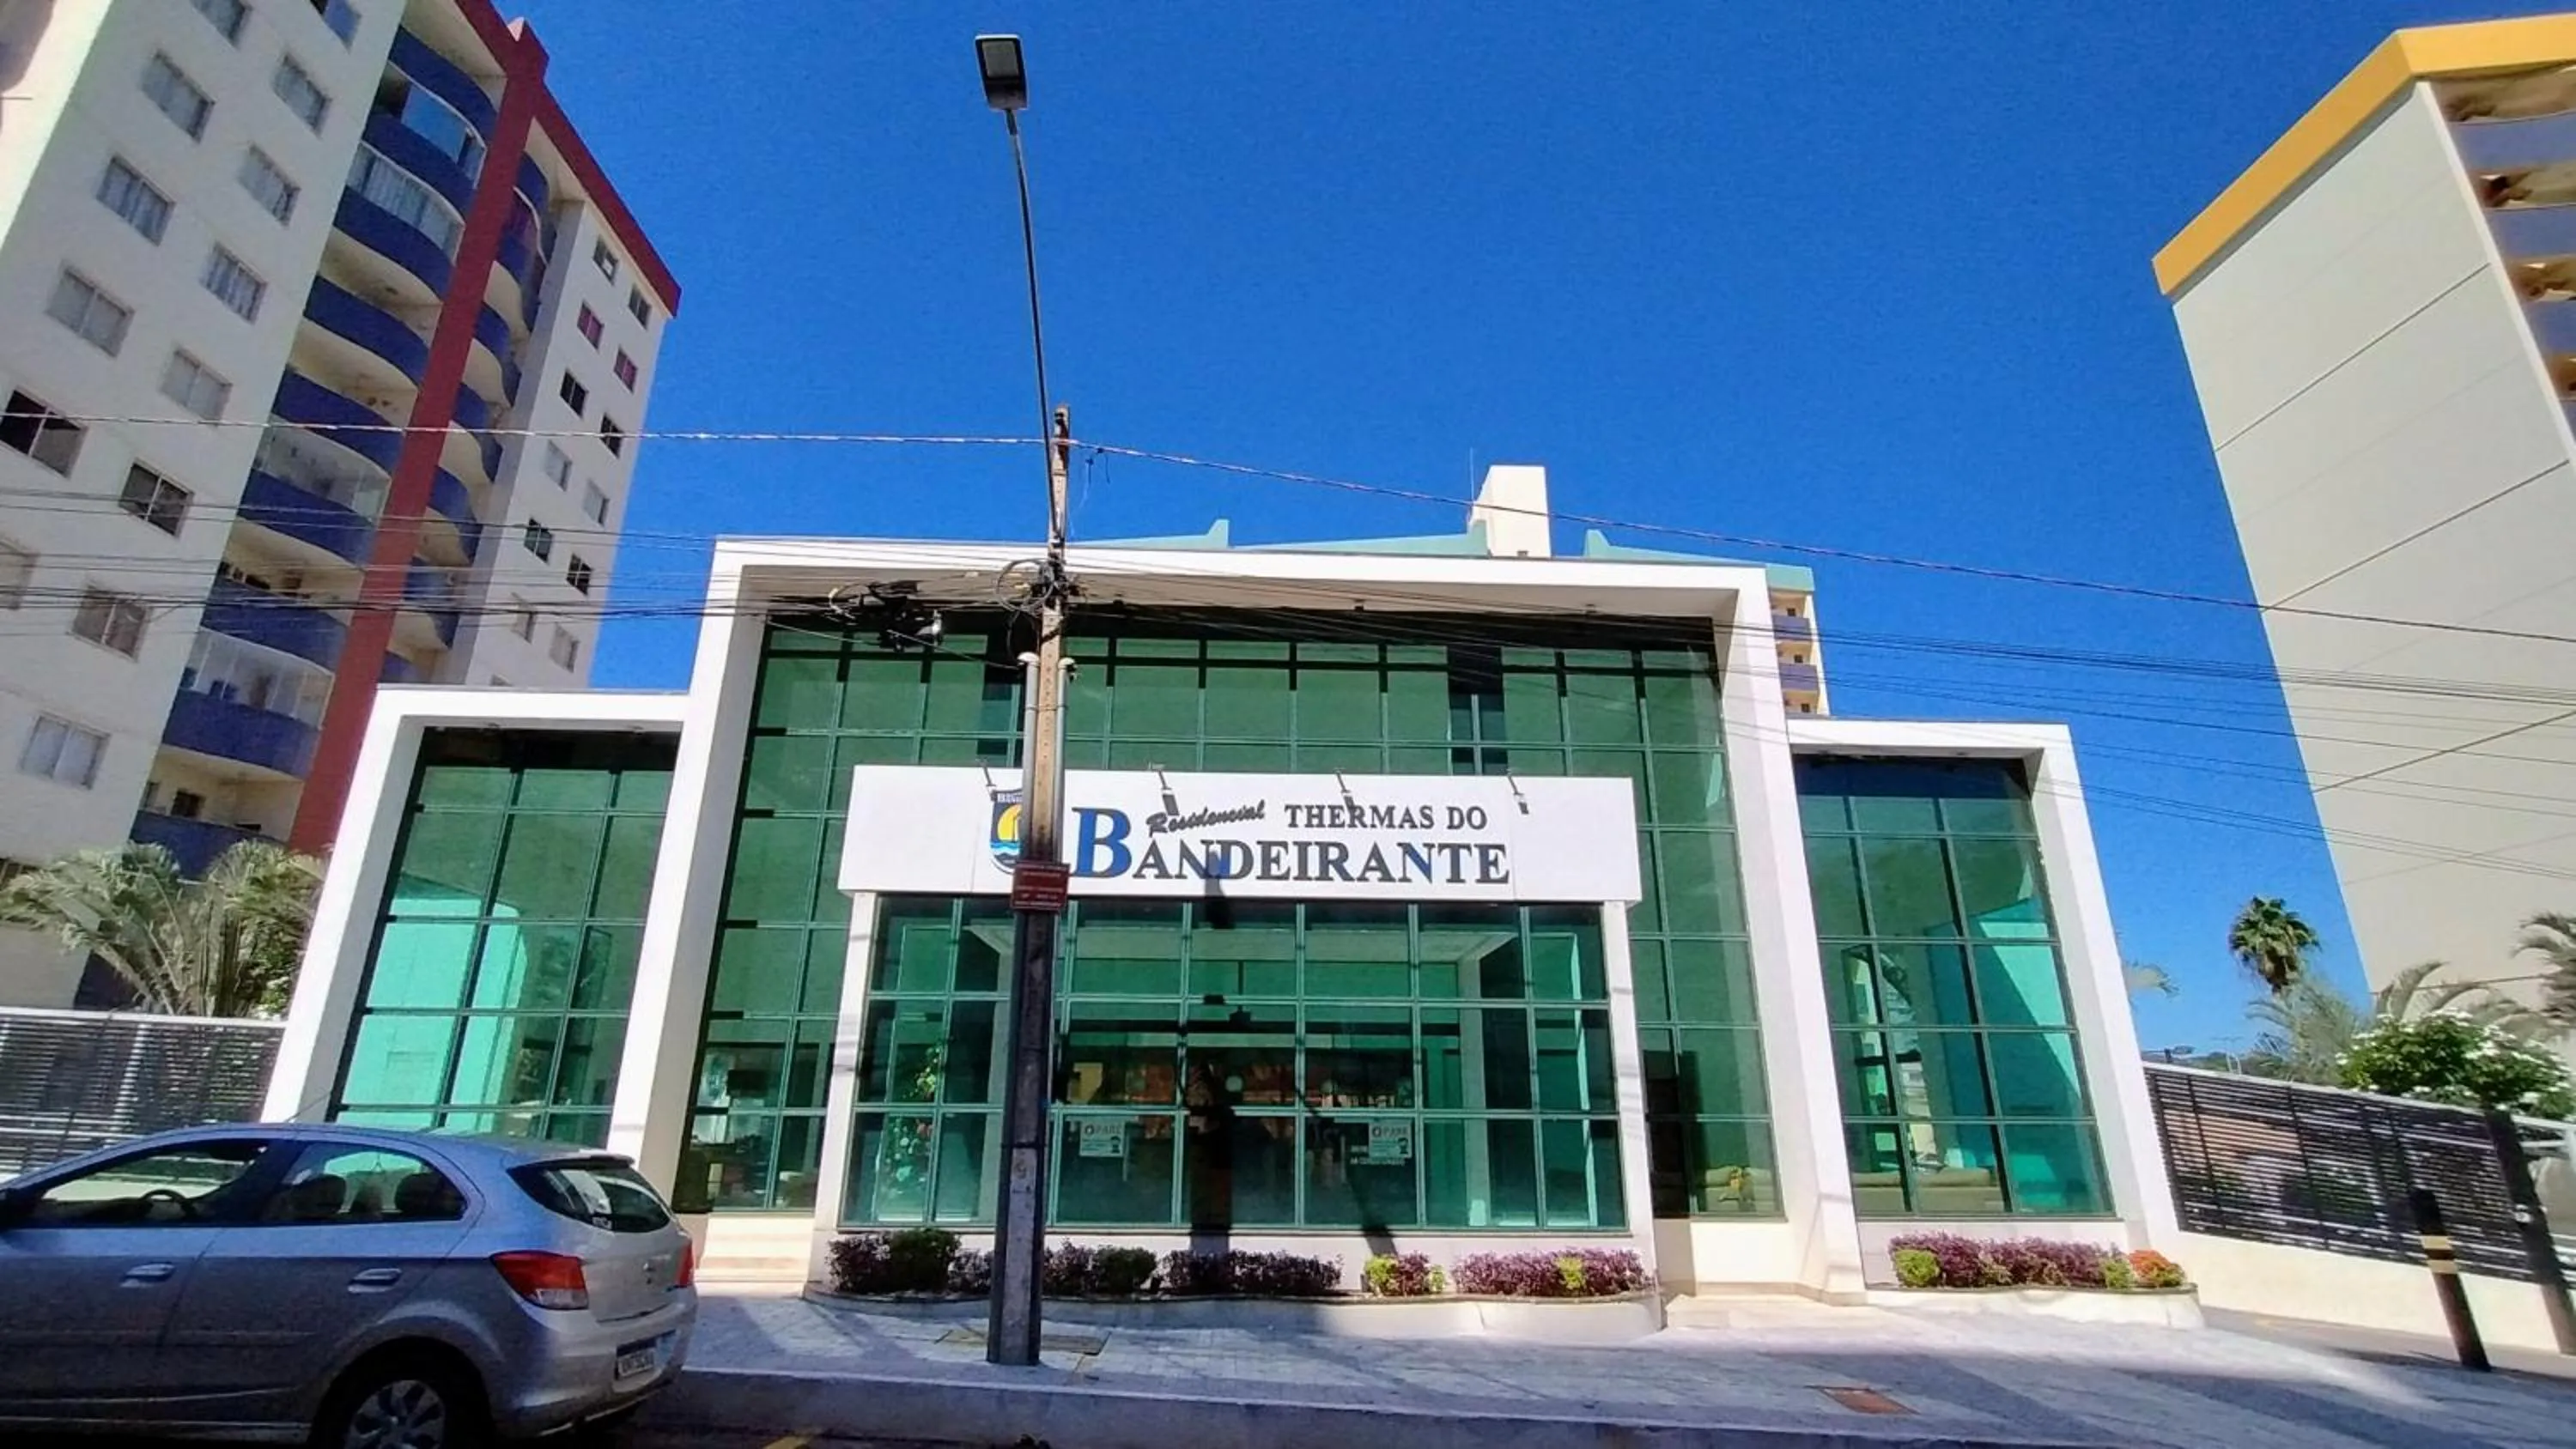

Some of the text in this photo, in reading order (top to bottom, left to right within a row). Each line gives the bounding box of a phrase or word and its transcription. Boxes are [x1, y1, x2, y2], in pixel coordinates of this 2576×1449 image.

[1284, 804, 1435, 830] THERMAS
[1446, 806, 1488, 830] DO
[1070, 806, 1510, 884] BANDEIRANTE
